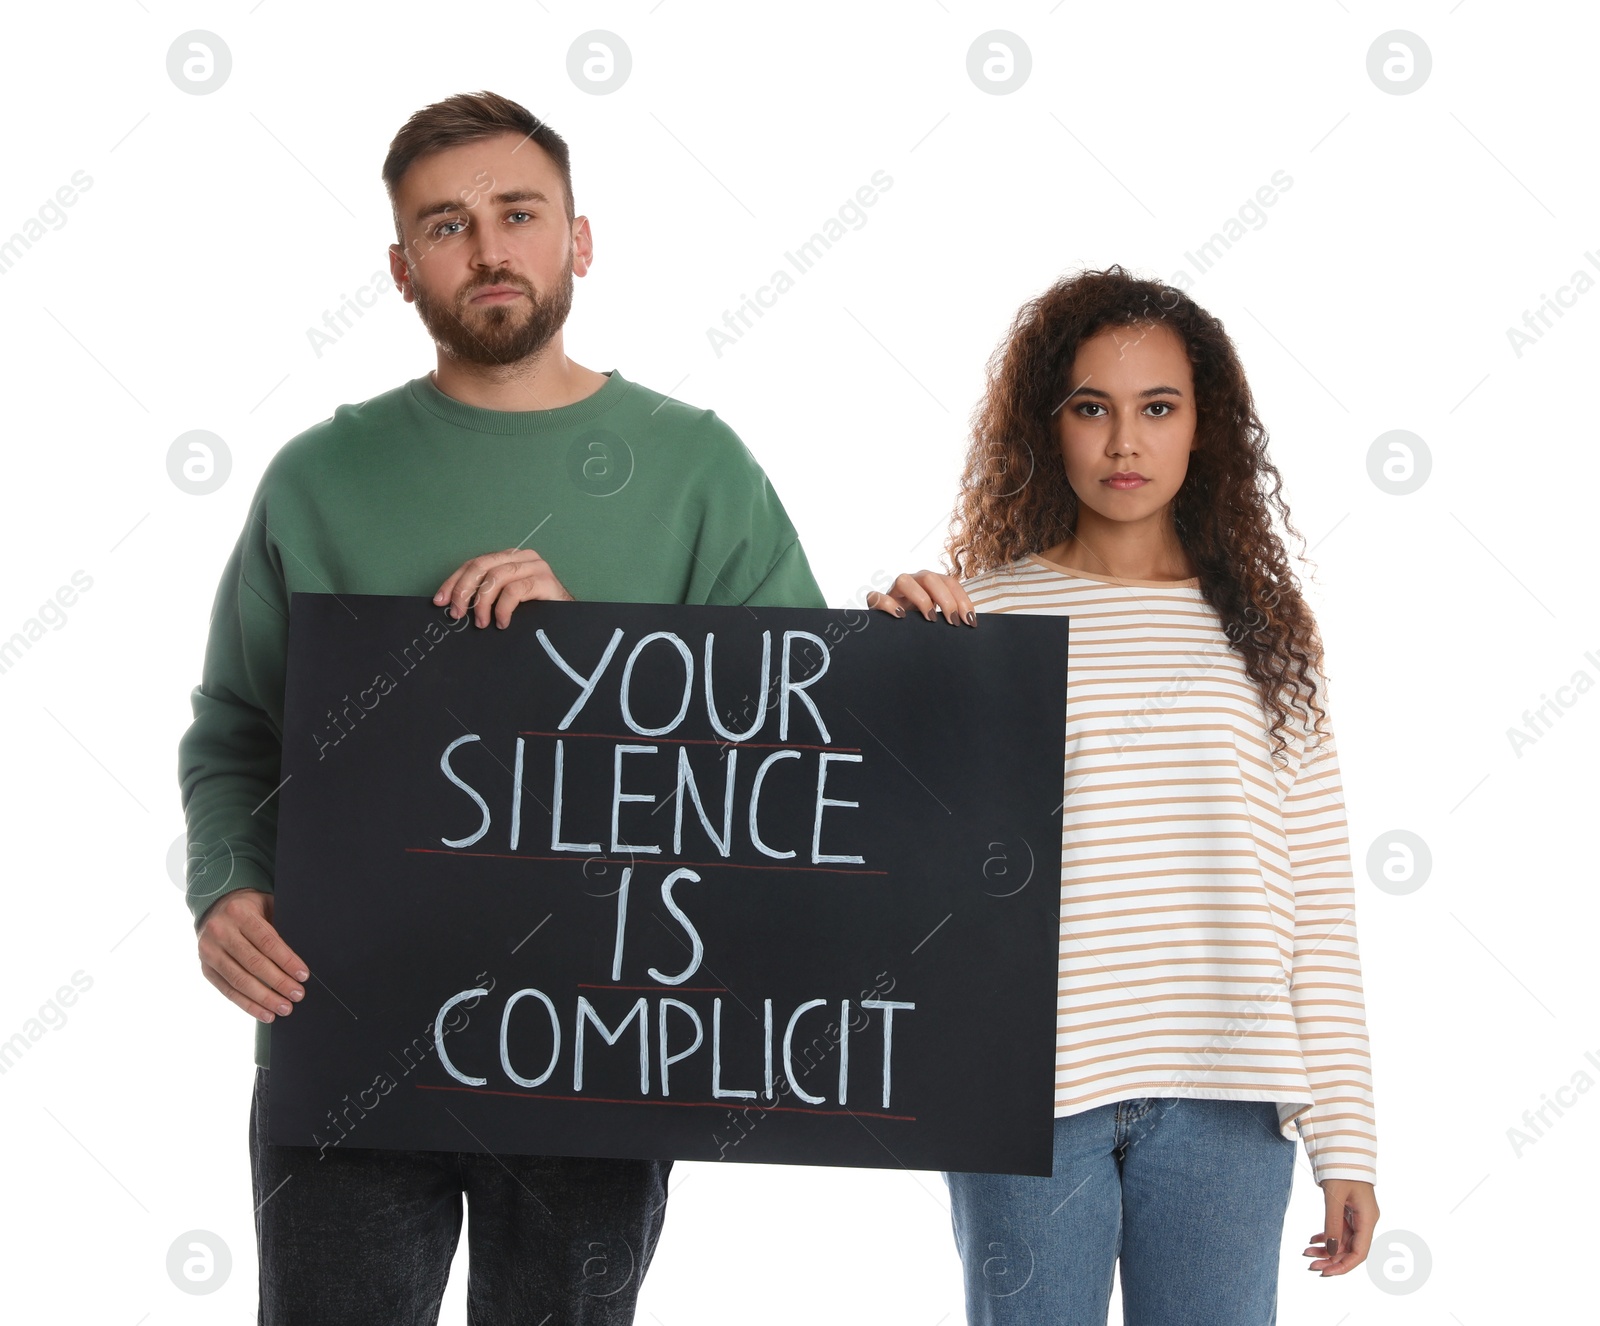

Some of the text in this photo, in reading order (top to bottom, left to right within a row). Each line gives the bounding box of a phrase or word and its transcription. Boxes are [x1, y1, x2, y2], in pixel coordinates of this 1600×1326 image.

[534, 627, 832, 745] YOUR
[440, 733, 866, 865] SILENCE
[611, 867, 704, 986] IS
[433, 987, 916, 1109] COMPLICIT
